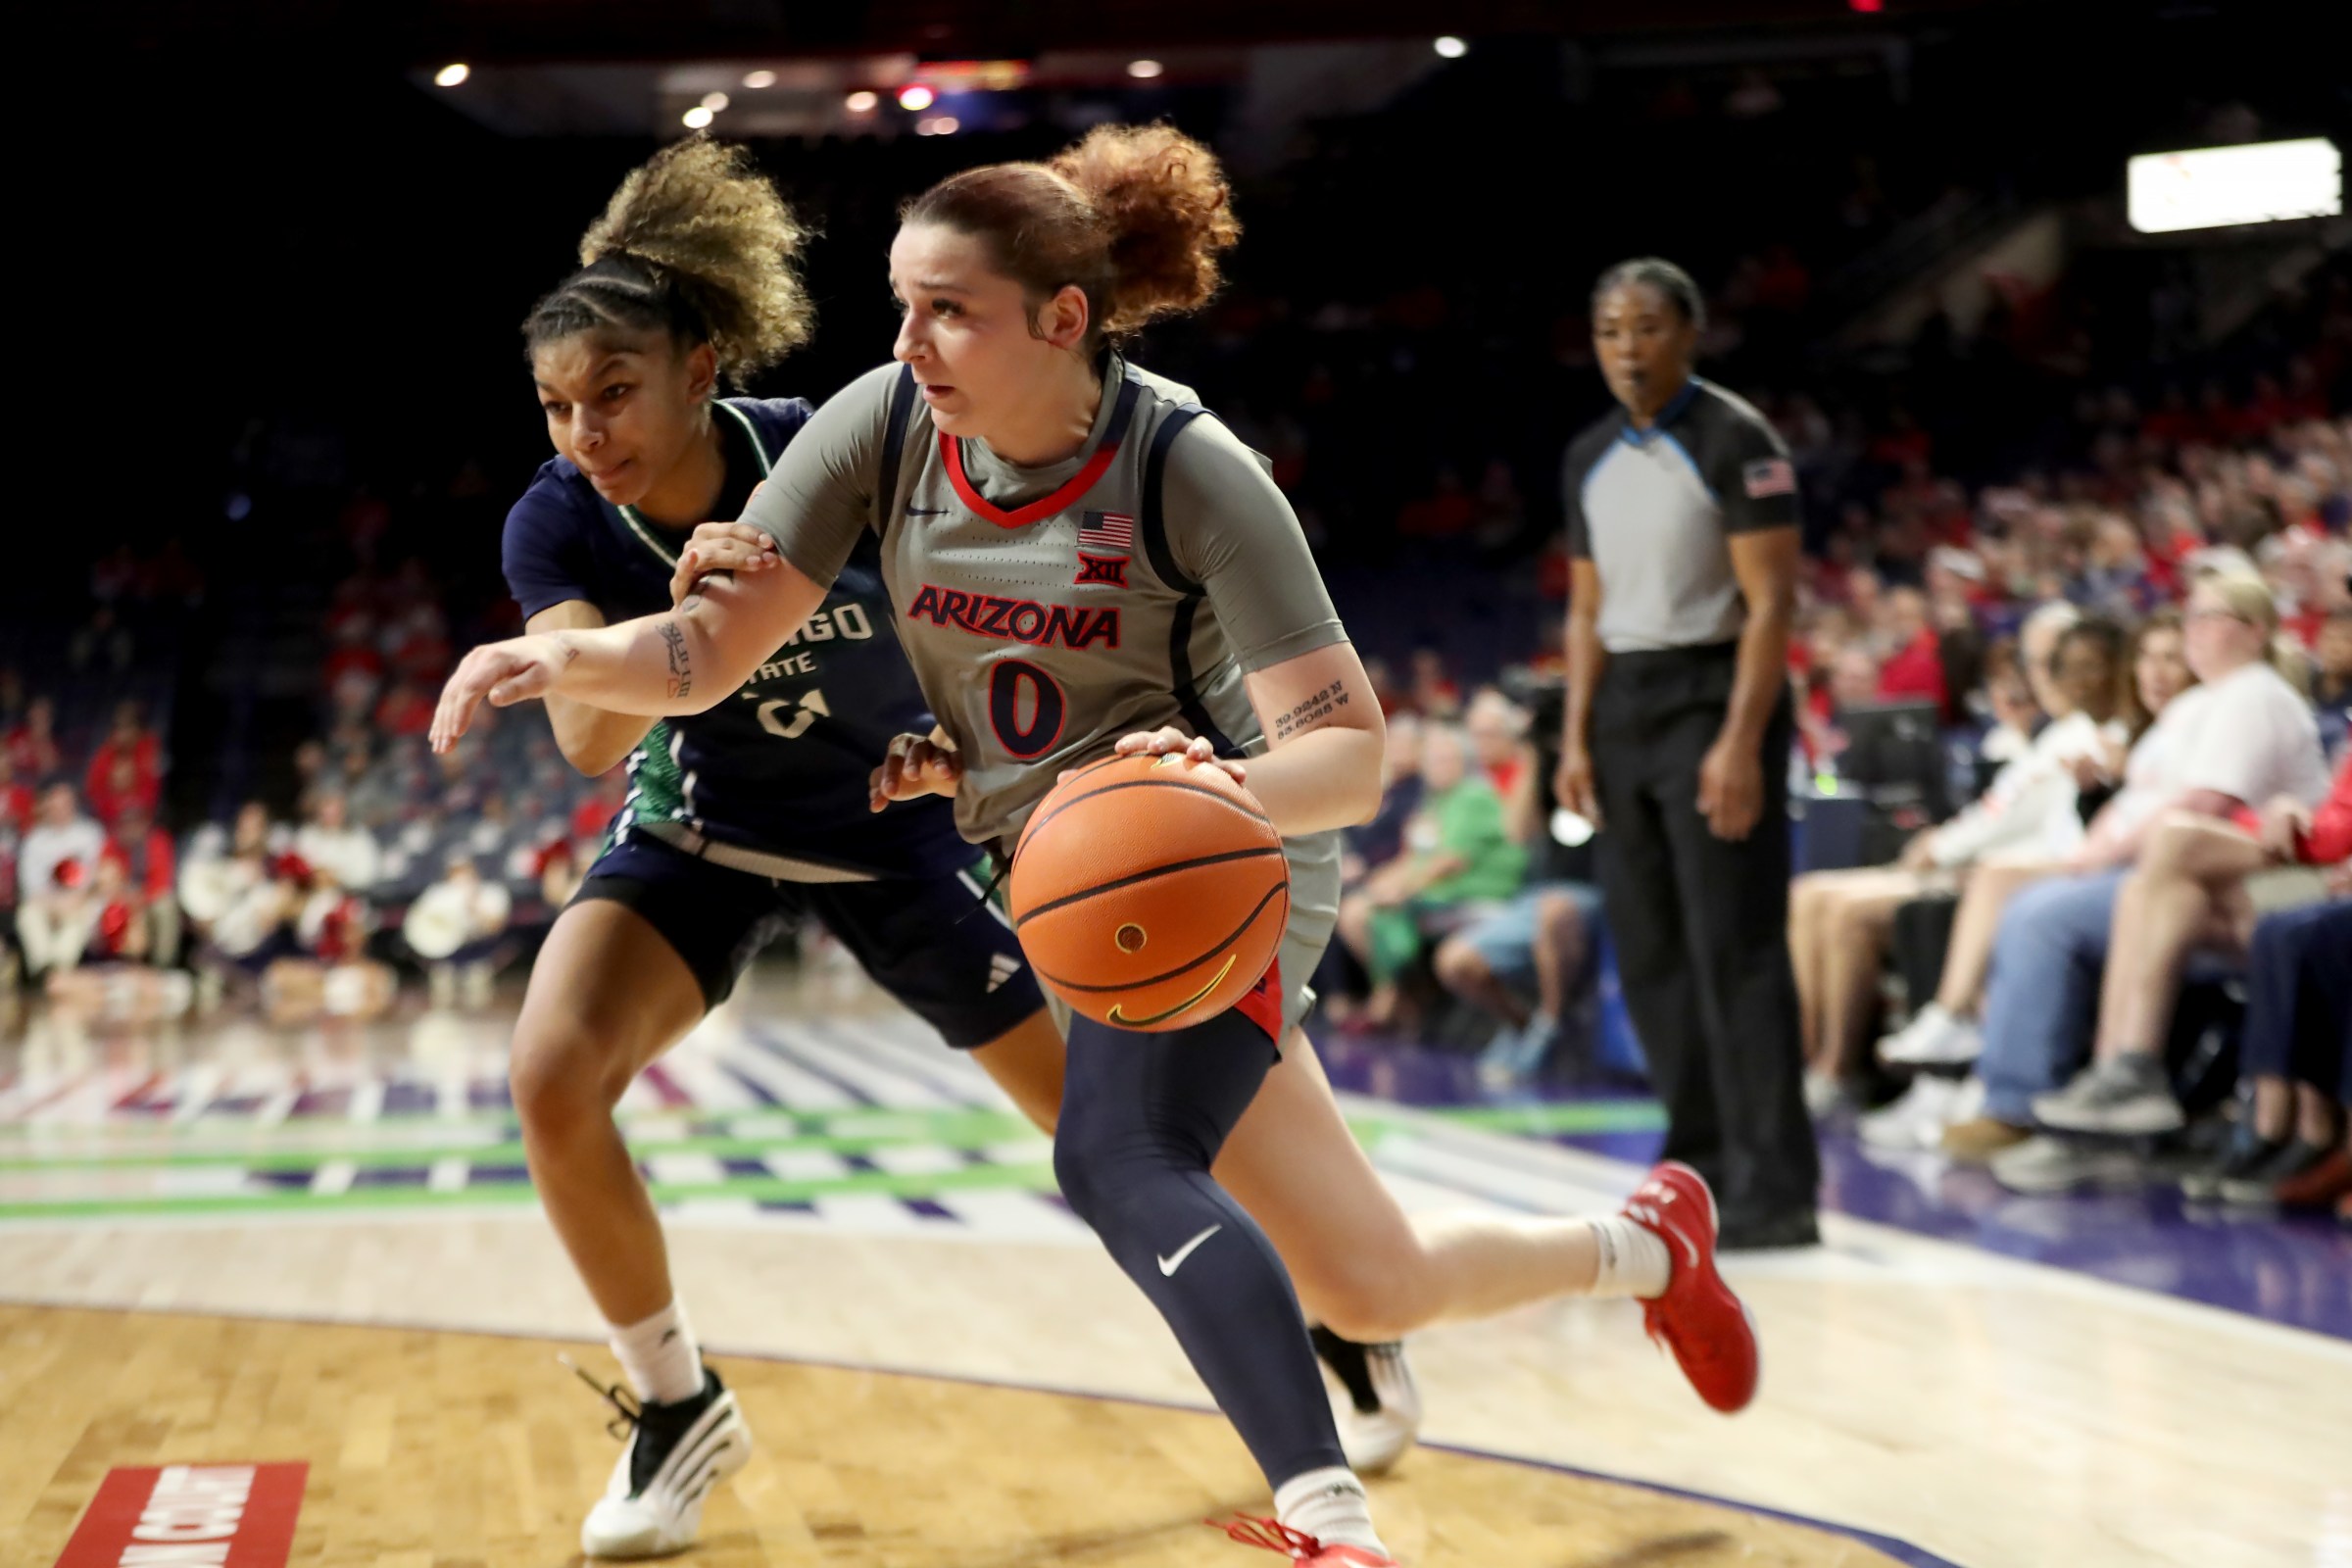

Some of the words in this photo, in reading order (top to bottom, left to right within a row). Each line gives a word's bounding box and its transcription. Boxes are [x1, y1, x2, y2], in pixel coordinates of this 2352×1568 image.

[1077, 555, 1128, 586] XII
[907, 584, 1121, 651] ARIZONA
[989, 659, 1066, 760] 0
